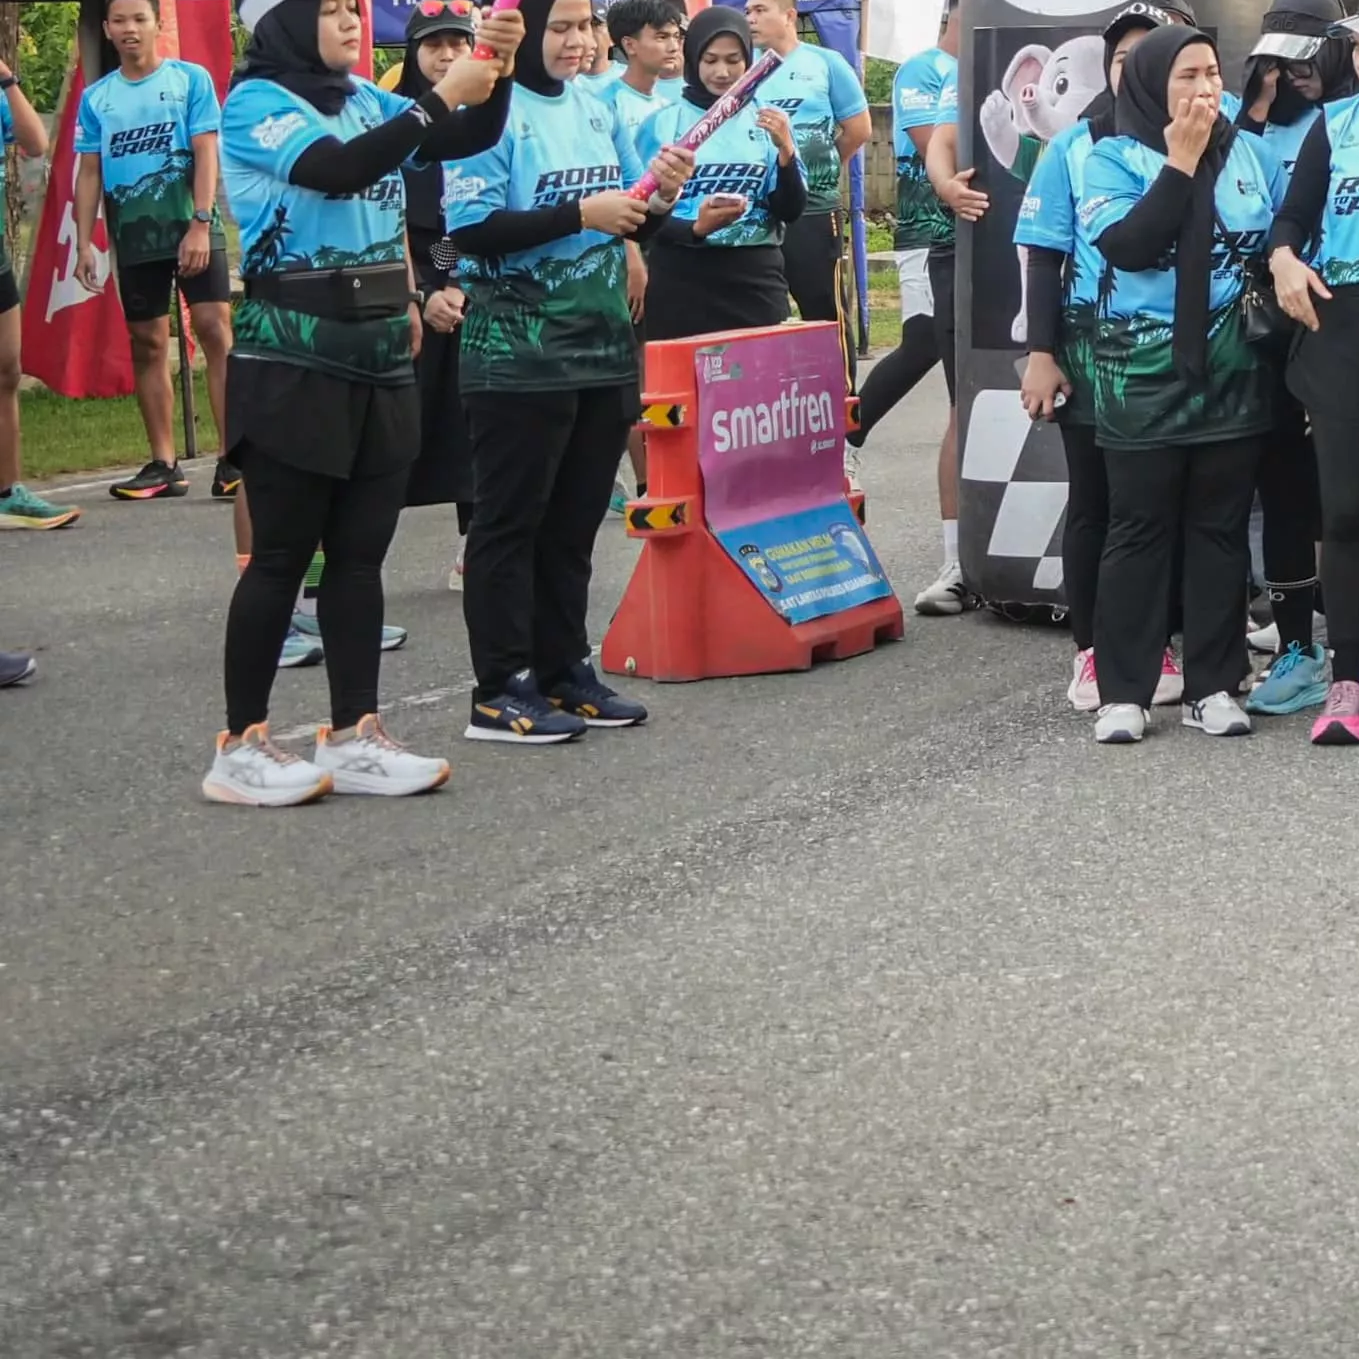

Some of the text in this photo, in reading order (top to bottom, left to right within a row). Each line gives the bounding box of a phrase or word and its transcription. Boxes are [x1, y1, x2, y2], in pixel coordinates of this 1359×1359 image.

[110, 121, 177, 145] ROAD
[1334, 196, 1349, 206] TO
[711, 381, 835, 453] smartfren
